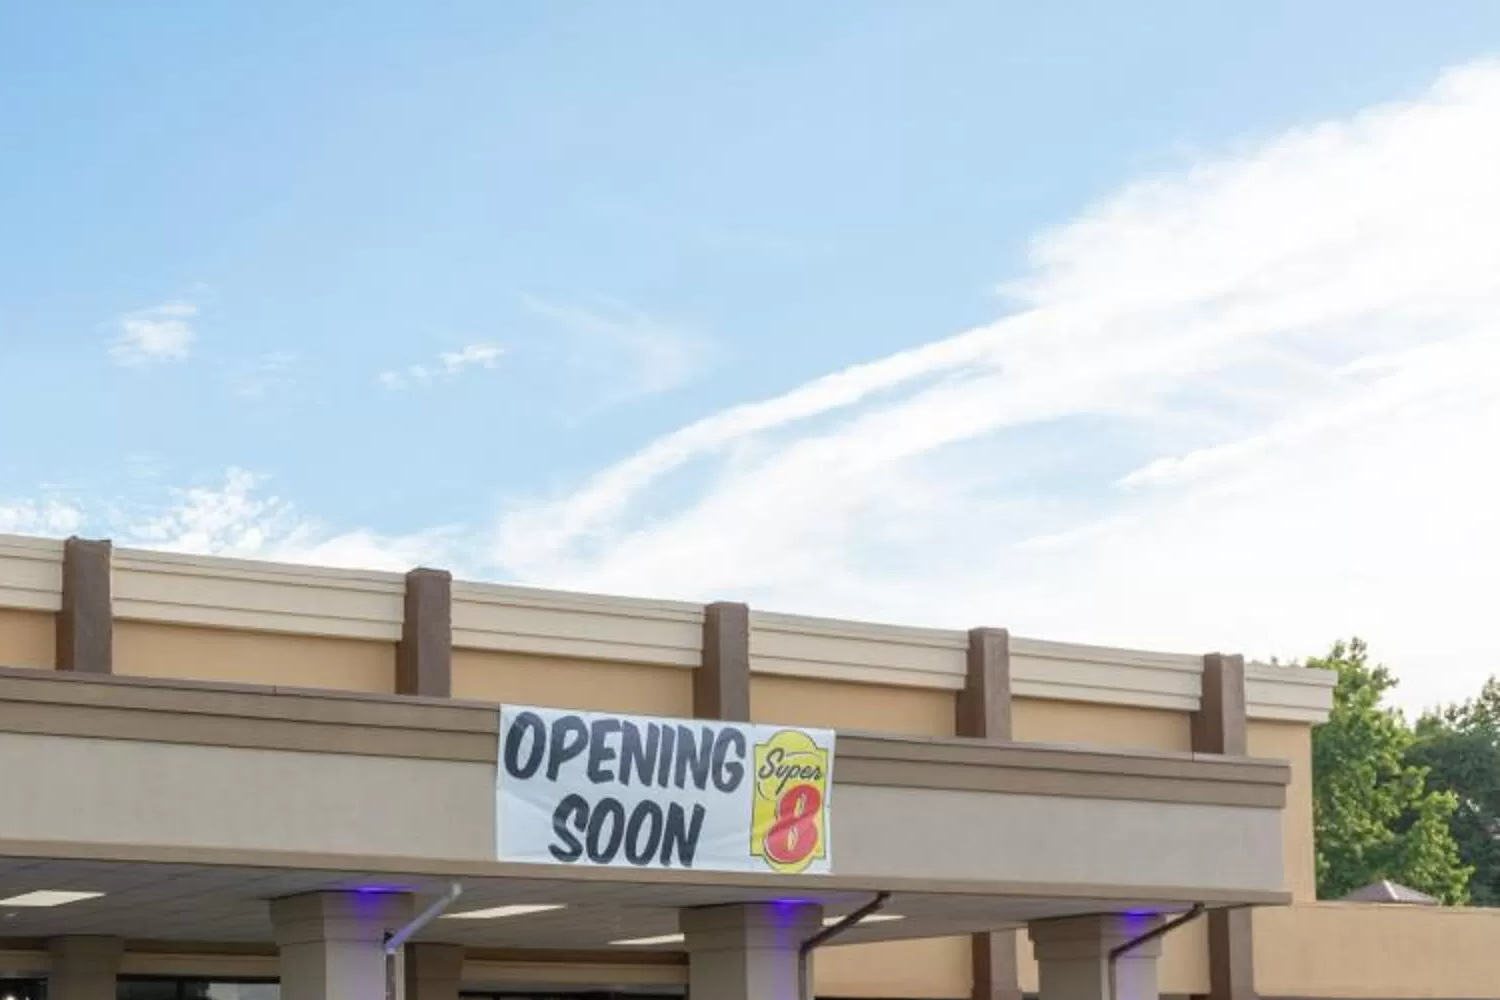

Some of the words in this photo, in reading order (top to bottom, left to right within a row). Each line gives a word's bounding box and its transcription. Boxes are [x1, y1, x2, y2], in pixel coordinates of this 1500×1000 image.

[504, 711, 746, 794] OPENING
[757, 747, 823, 796] Super
[548, 793, 706, 867] SOON
[762, 783, 822, 864] 8
